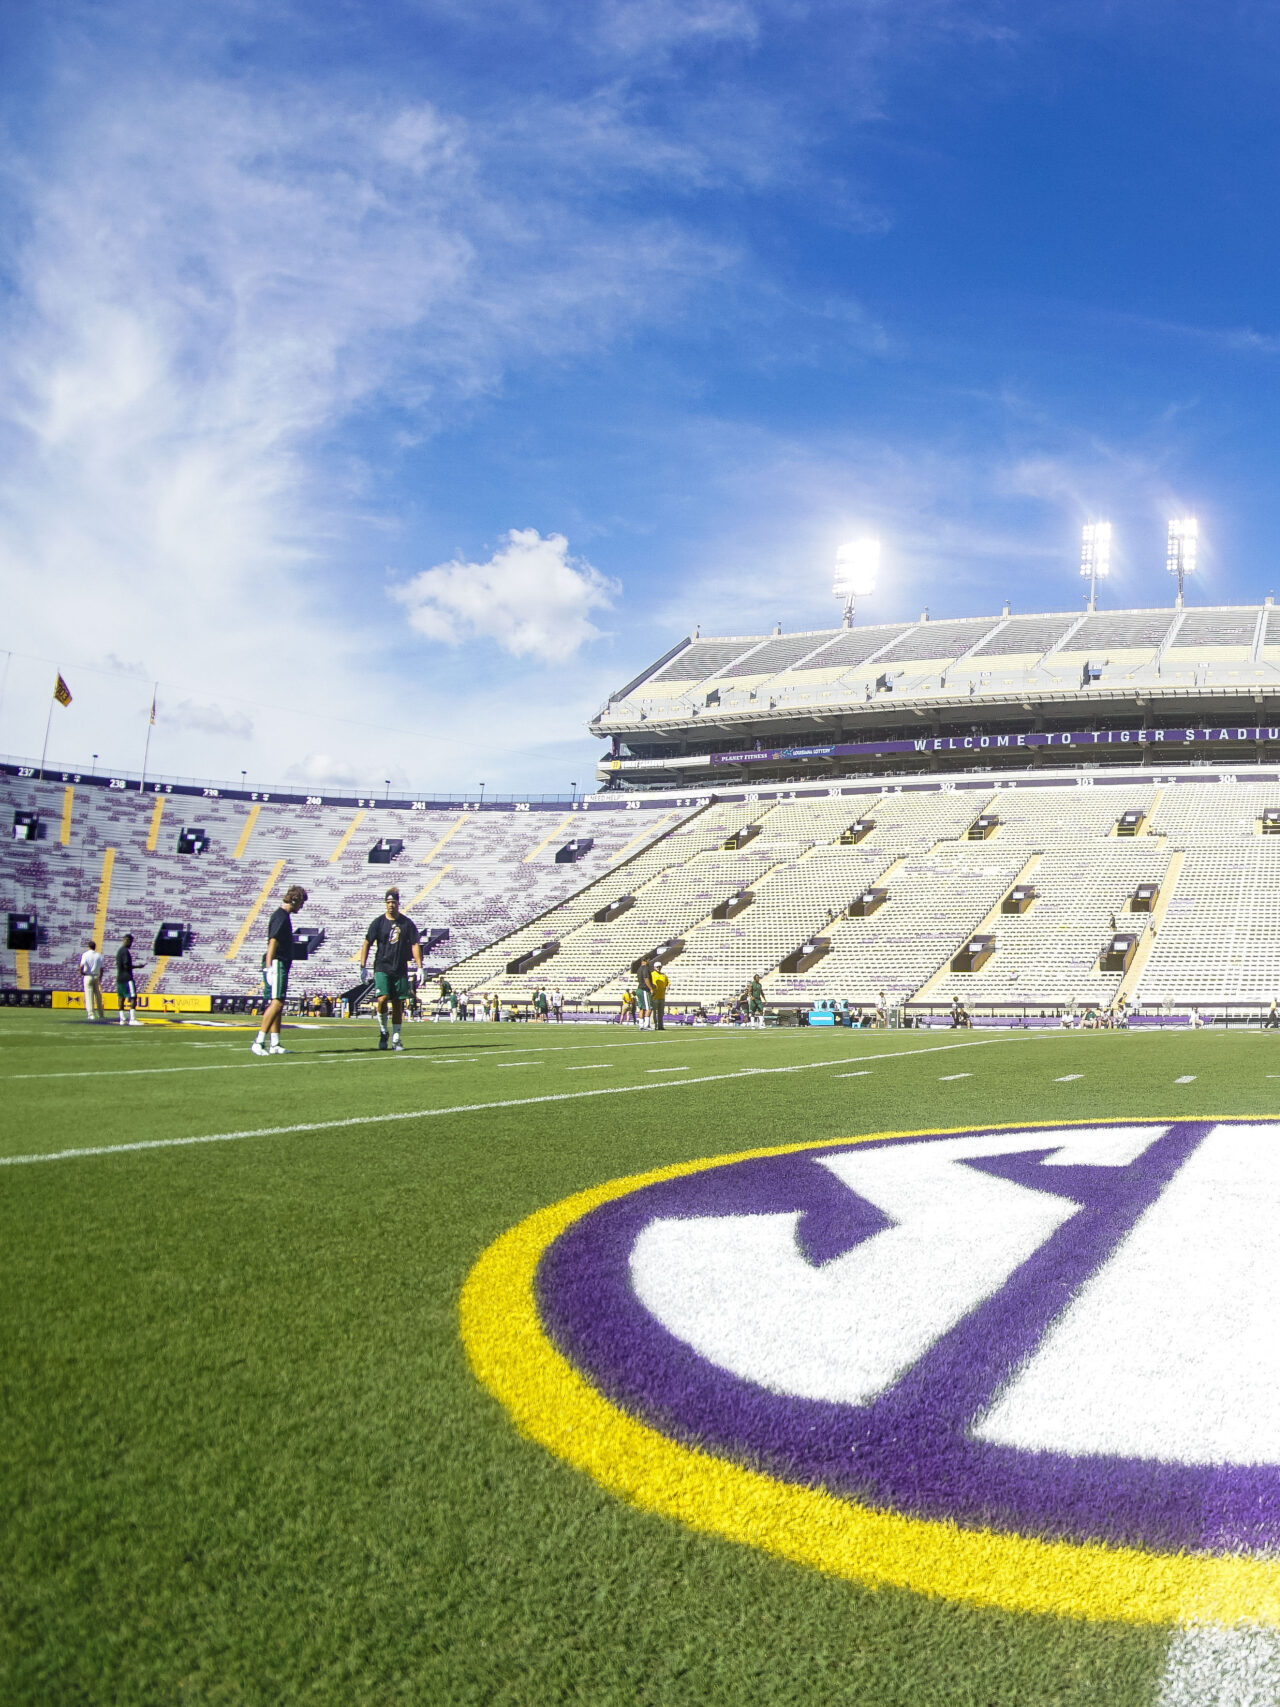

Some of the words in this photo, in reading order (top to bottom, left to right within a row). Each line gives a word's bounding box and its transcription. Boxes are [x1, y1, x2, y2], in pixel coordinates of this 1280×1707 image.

[914, 734, 1026, 750] WELCOME
[1046, 733, 1072, 744] TO
[1092, 730, 1164, 742] TIGER
[18, 767, 35, 777] 237
[110, 779, 126, 789] 238
[1076, 778, 1094, 786] 303
[940, 783, 956, 791] 302
[412, 802, 426, 810] 241
[515, 803, 530, 812] 242
[626, 801, 640, 810] 243
